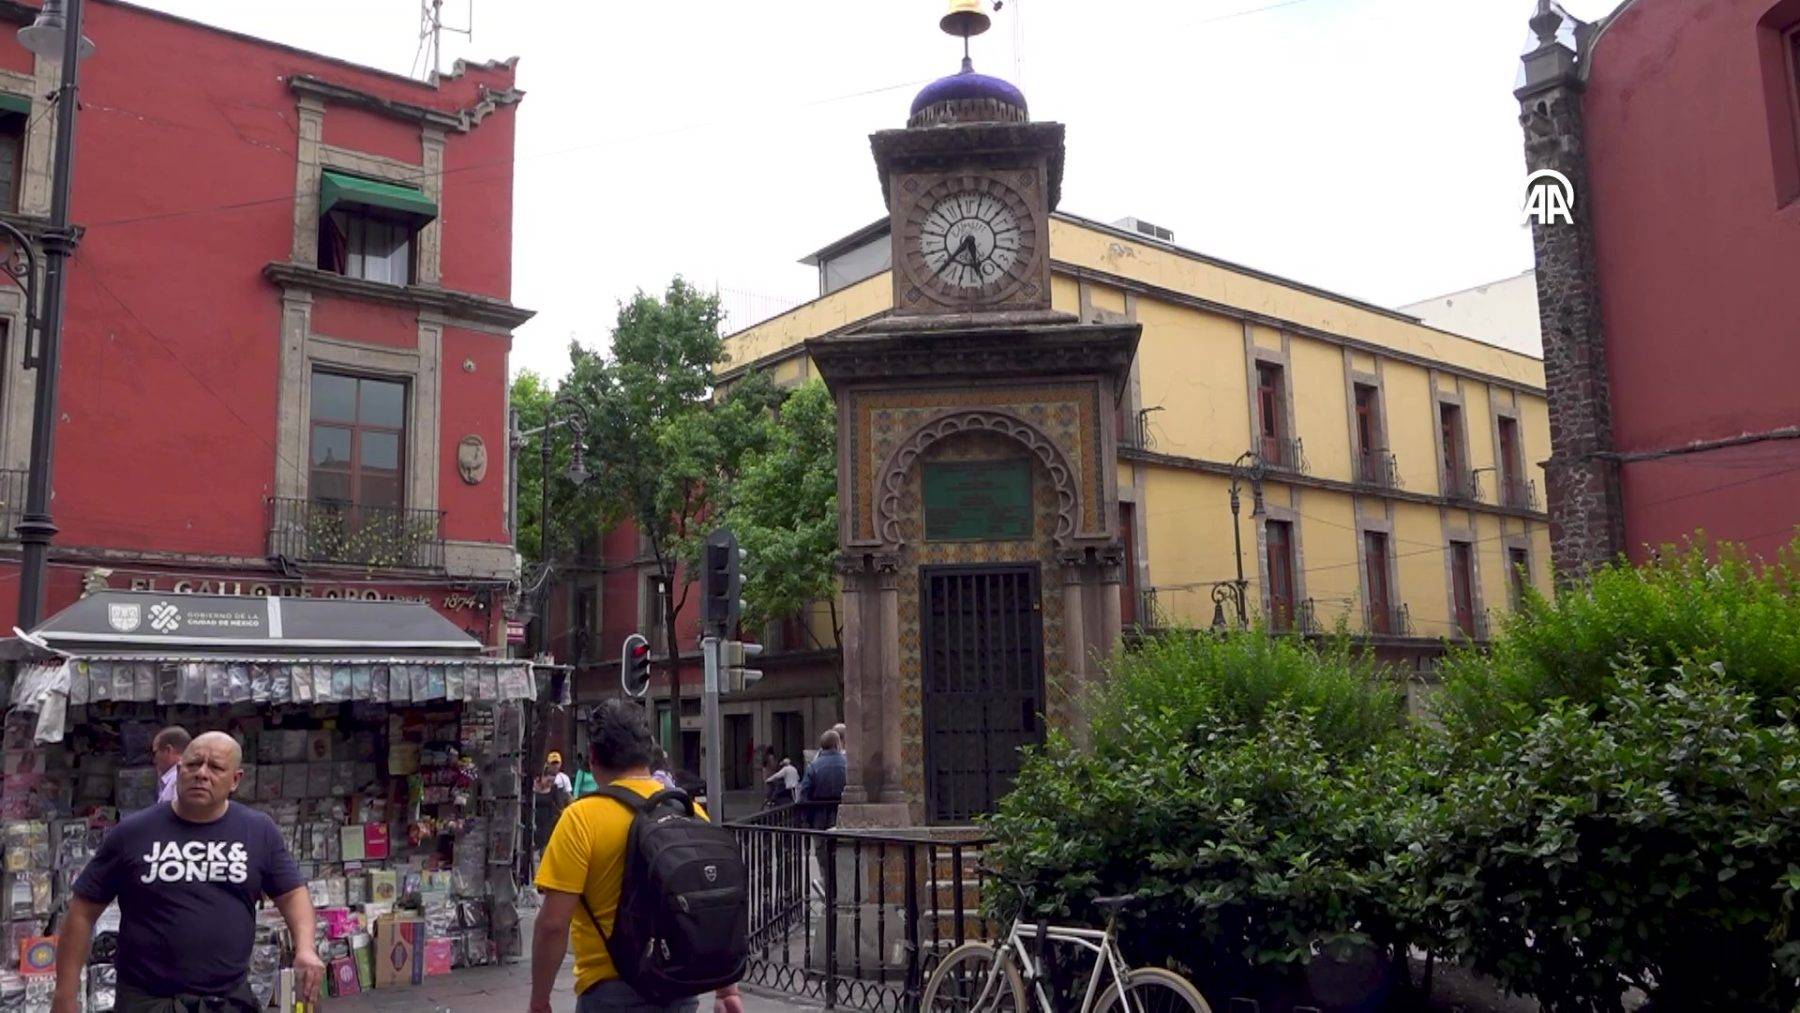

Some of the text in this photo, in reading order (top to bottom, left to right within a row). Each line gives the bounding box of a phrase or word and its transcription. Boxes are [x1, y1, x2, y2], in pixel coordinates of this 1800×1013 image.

[443, 593, 475, 611] 1874
[218, 619, 229, 627] DE
[143, 841, 248, 863] JACK&
[140, 861, 248, 884] JONES
